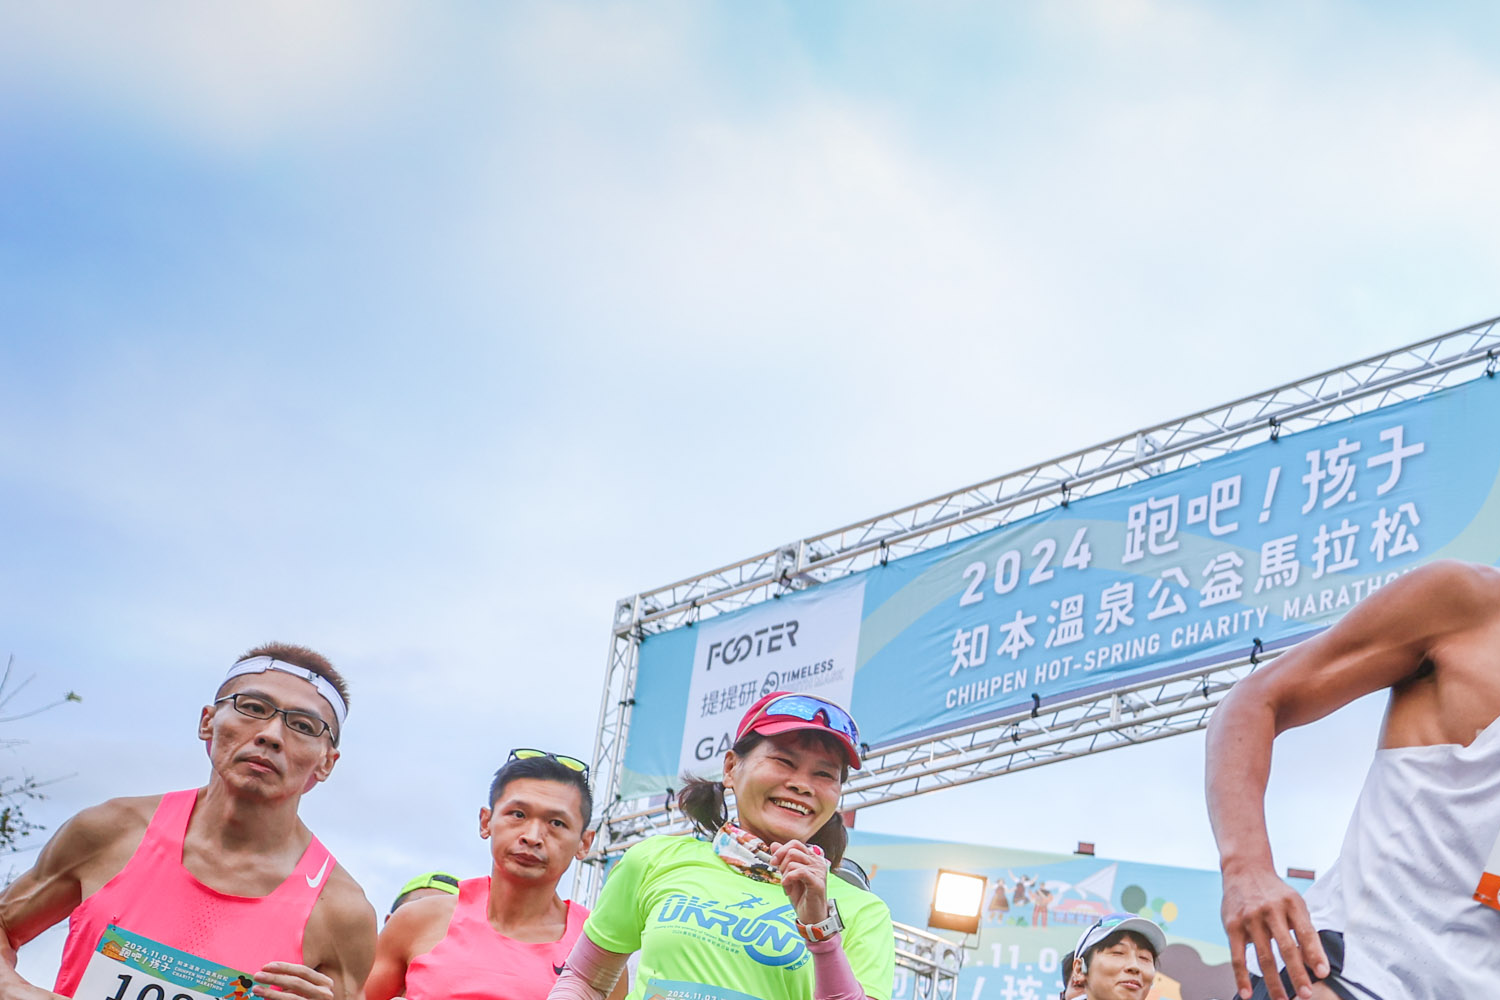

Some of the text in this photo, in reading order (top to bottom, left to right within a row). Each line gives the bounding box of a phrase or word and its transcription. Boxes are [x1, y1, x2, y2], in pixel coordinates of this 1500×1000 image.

[959, 425, 1425, 607] 2024 跑吧！孩子
[949, 502, 1421, 677] 知本溫泉公益馬拉松
[706, 620, 799, 671] FOOTER
[946, 565, 1418, 709] CHIHPEN HOT-SPRING CHARITY MARATHO
[781, 659, 835, 684] TIMELESS
[700, 680, 758, 718] 提提研
[124, 940, 174, 963] 2024.11.03
